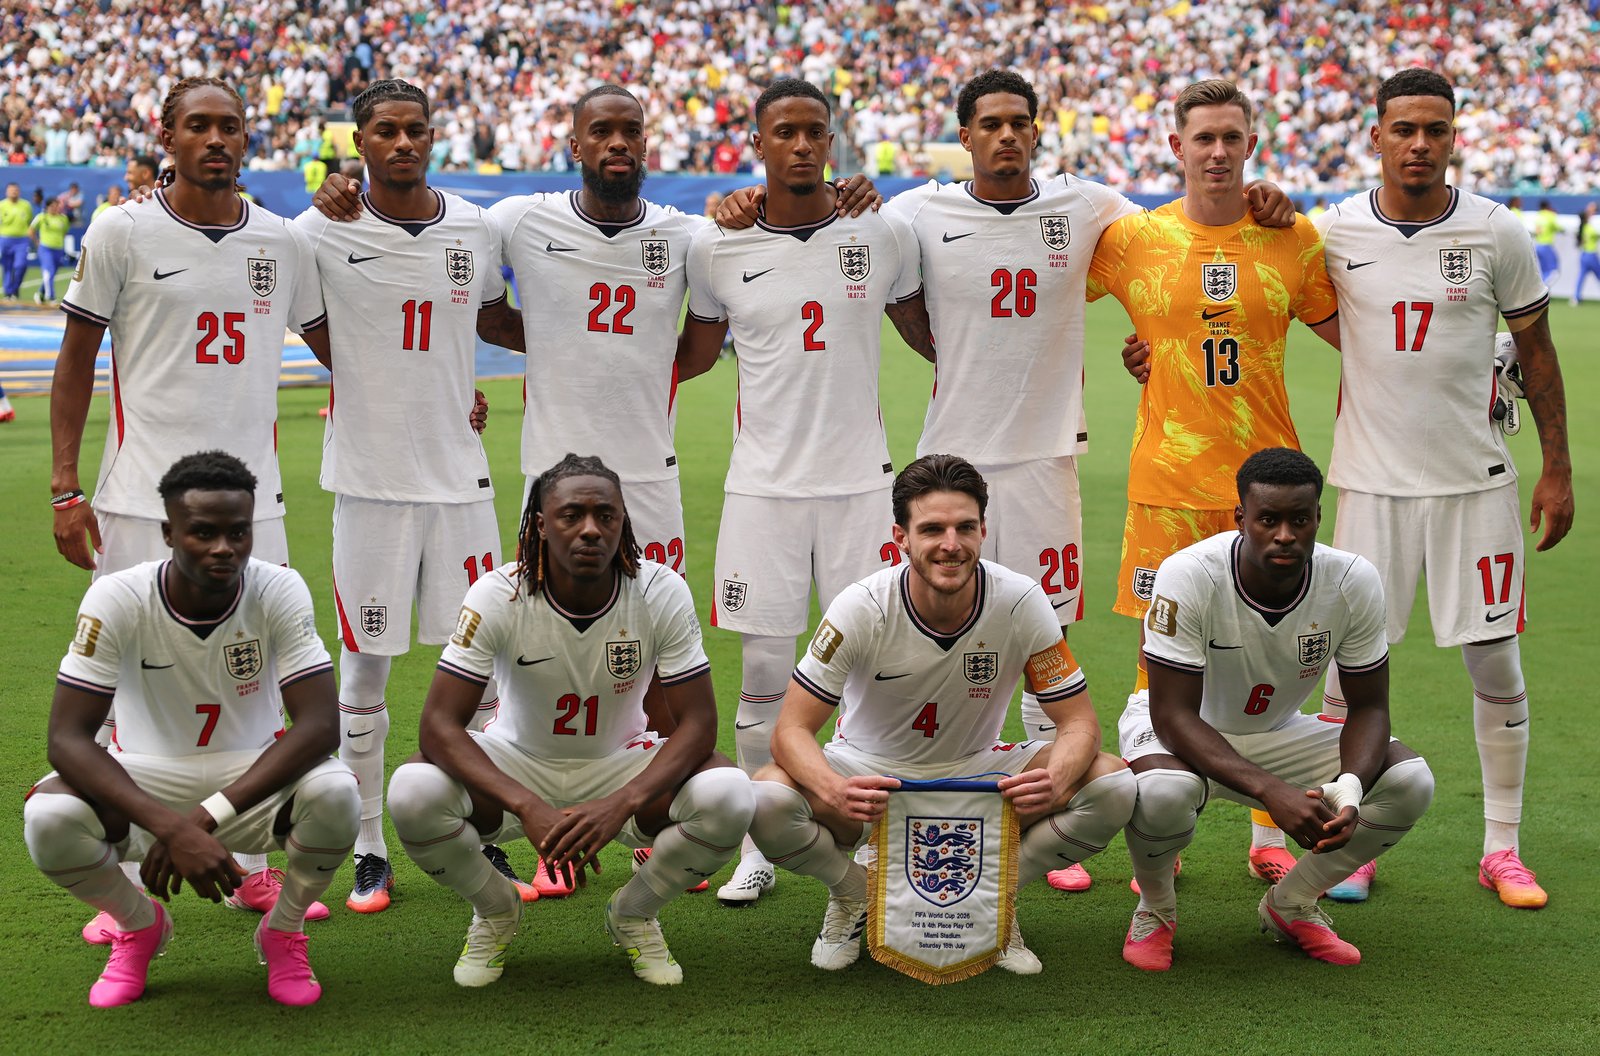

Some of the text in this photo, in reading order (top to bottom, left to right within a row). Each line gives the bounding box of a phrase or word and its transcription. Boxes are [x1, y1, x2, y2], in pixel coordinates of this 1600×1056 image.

[1048, 253, 1069, 261] FRANCE
[253, 299, 271, 307] FRANCE
[450, 289, 470, 297] FRANCE
[991, 268, 1037, 318] 26
[587, 283, 636, 336] 22
[195, 311, 246, 366] 25
[402, 299, 434, 352] 11
[801, 301, 826, 352] 2
[1391, 301, 1434, 353] 17
[1201, 338, 1240, 387] 13
[1039, 543, 1081, 595] 26
[1477, 552, 1514, 605] 17
[1030, 647, 1060, 664] FOOTBALL
[1031, 653, 1064, 673] UNITES
[1036, 660, 1069, 681] the World
[1299, 665, 1320, 674] FRANCE
[236, 680, 260, 691] FRANCE
[613, 678, 636, 689] FRANCE
[1048, 675, 1063, 684] FIFA
[553, 693, 598, 735] 21
[1244, 684, 1273, 714] 6
[196, 703, 221, 747] 7
[911, 702, 938, 738] 4
[944, 912, 955, 920] Cup
[918, 942, 942, 950] Saturday
[955, 942, 966, 950] July
